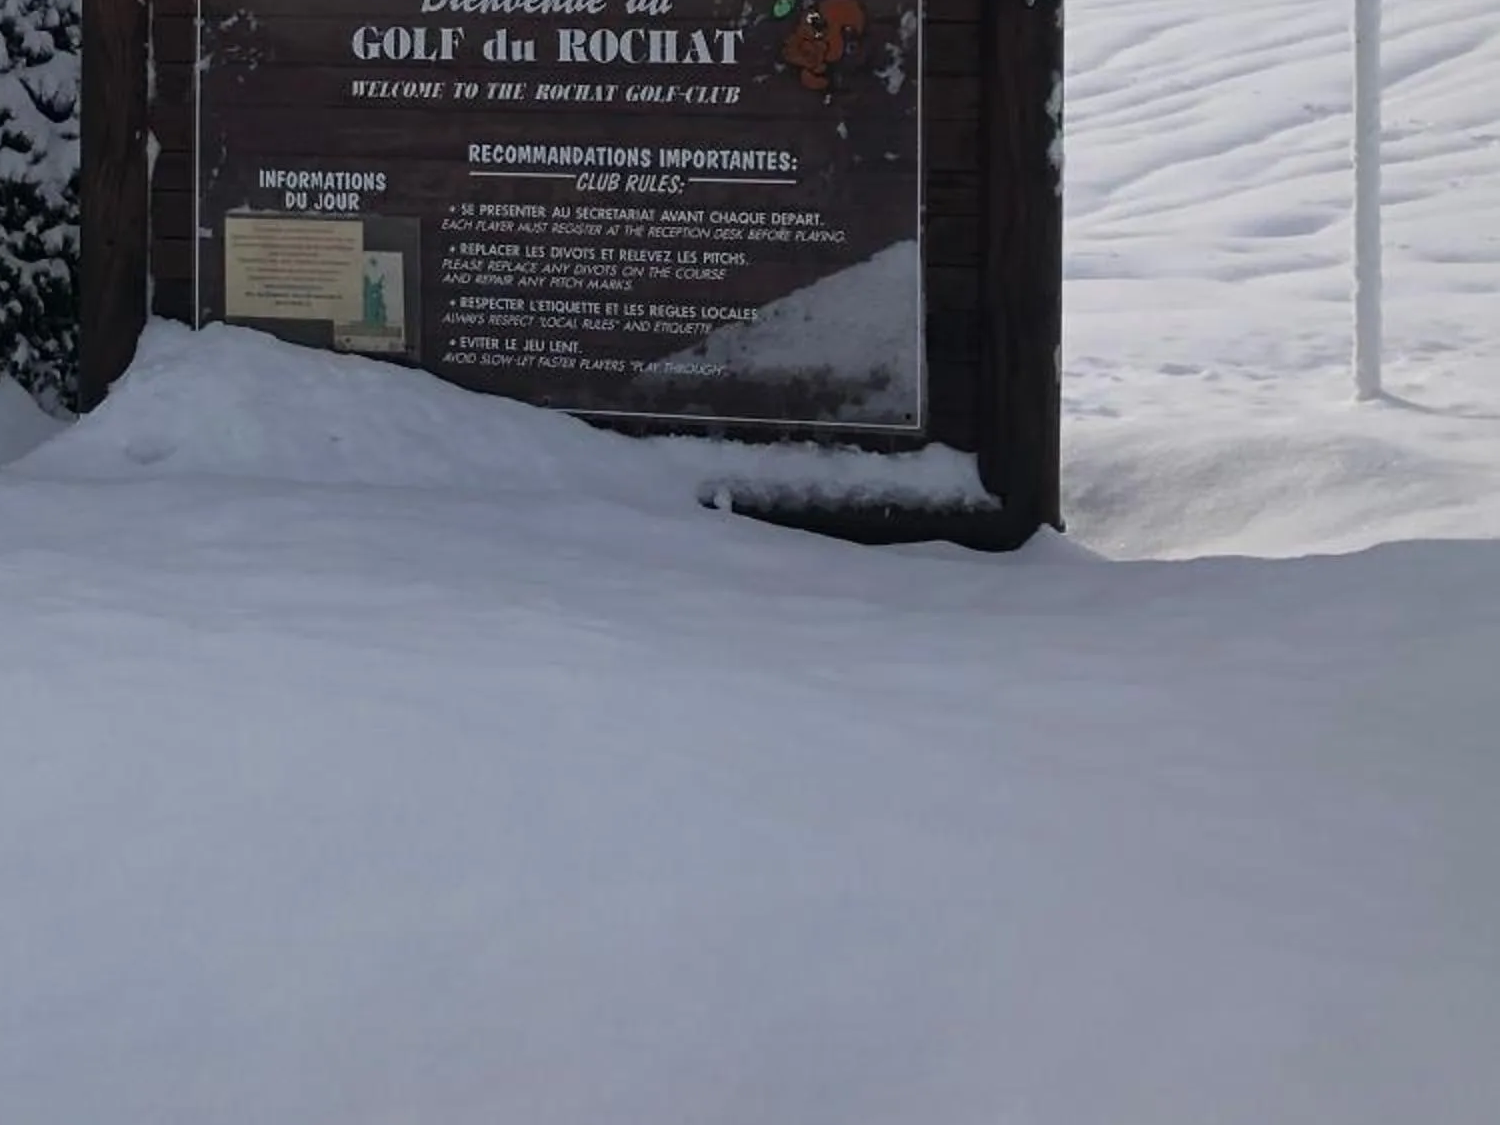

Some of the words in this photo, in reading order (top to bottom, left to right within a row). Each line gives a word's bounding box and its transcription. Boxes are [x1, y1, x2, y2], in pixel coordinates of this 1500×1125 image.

[352, 26, 465, 62] GOLF
[483, 28, 537, 62] du
[557, 28, 744, 64] ROCHAT
[352, 80, 445, 99] WELCOME
[453, 82, 479, 100] TO
[487, 82, 527, 101] THE
[535, 83, 619, 102] ROCHAT
[625, 85, 741, 104] GOLF-CLUB
[468, 144, 651, 168] RECOMMANDATIONS
[659, 148, 799, 172] IMPORTANTES:
[259, 169, 387, 191] INFORMATIONS
[575, 172, 621, 192] CLUB
[625, 174, 685, 194] RULES:
[285, 192, 308, 209] DU
[313, 193, 361, 211] JOUR
[461, 203, 475, 216] SE
[479, 204, 547, 218] PRESENTER
[551, 206, 571, 219] AU
[575, 206, 656, 221] SECRETARIAT
[660, 210, 705, 223] AVANT
[709, 211, 767, 225] CHAQUE
[771, 212, 825, 226] DEPART.
[441, 219, 473, 231] EACH
[475, 220, 514, 232] PLAYER
[517, 222, 548, 234] MUST
[551, 222, 602, 236] REGISTER
[606, 224, 621, 236] AT
[624, 224, 645, 237] THE
[647, 226, 711, 239] RECEPTION
[713, 228, 744, 241] DESK
[747, 228, 793, 242] BEFORE
[459, 243, 521, 257] REPLACER
[525, 245, 545, 258] LES
[550, 246, 596, 260] DIVOTS
[600, 248, 615, 261] ET
[619, 248, 672, 262] RELEVEZ
[677, 250, 697, 264] LES
[441, 258, 484, 271] PLEASE
[487, 260, 539, 273] REPLACE
[541, 262, 571, 275] ANY
[573, 263, 618, 277] DIVOTS
[621, 266, 645, 278] ON
[648, 266, 672, 279] THE
[442, 273, 471, 284] AND
[475, 274, 514, 286] REPAIR
[517, 276, 548, 287] ANY
[550, 277, 584, 289] PITCH
[459, 296, 525, 311] RESPECTER
[529, 299, 601, 314] L'ETIQUETTE
[605, 302, 619, 315] ET
[623, 303, 645, 317] LES
[649, 304, 697, 319] REGLES
[442, 312, 485, 324] ALWAYS
[488, 314, 534, 327] RESPECT
[622, 320, 651, 333] AND
[459, 336, 500, 350] EVITER
[505, 338, 517, 351] LE
[523, 338, 545, 352] JEU
[442, 352, 477, 365] AVOID
[538, 356, 577, 369] FASTER
[580, 358, 626, 372] PLAYERS
